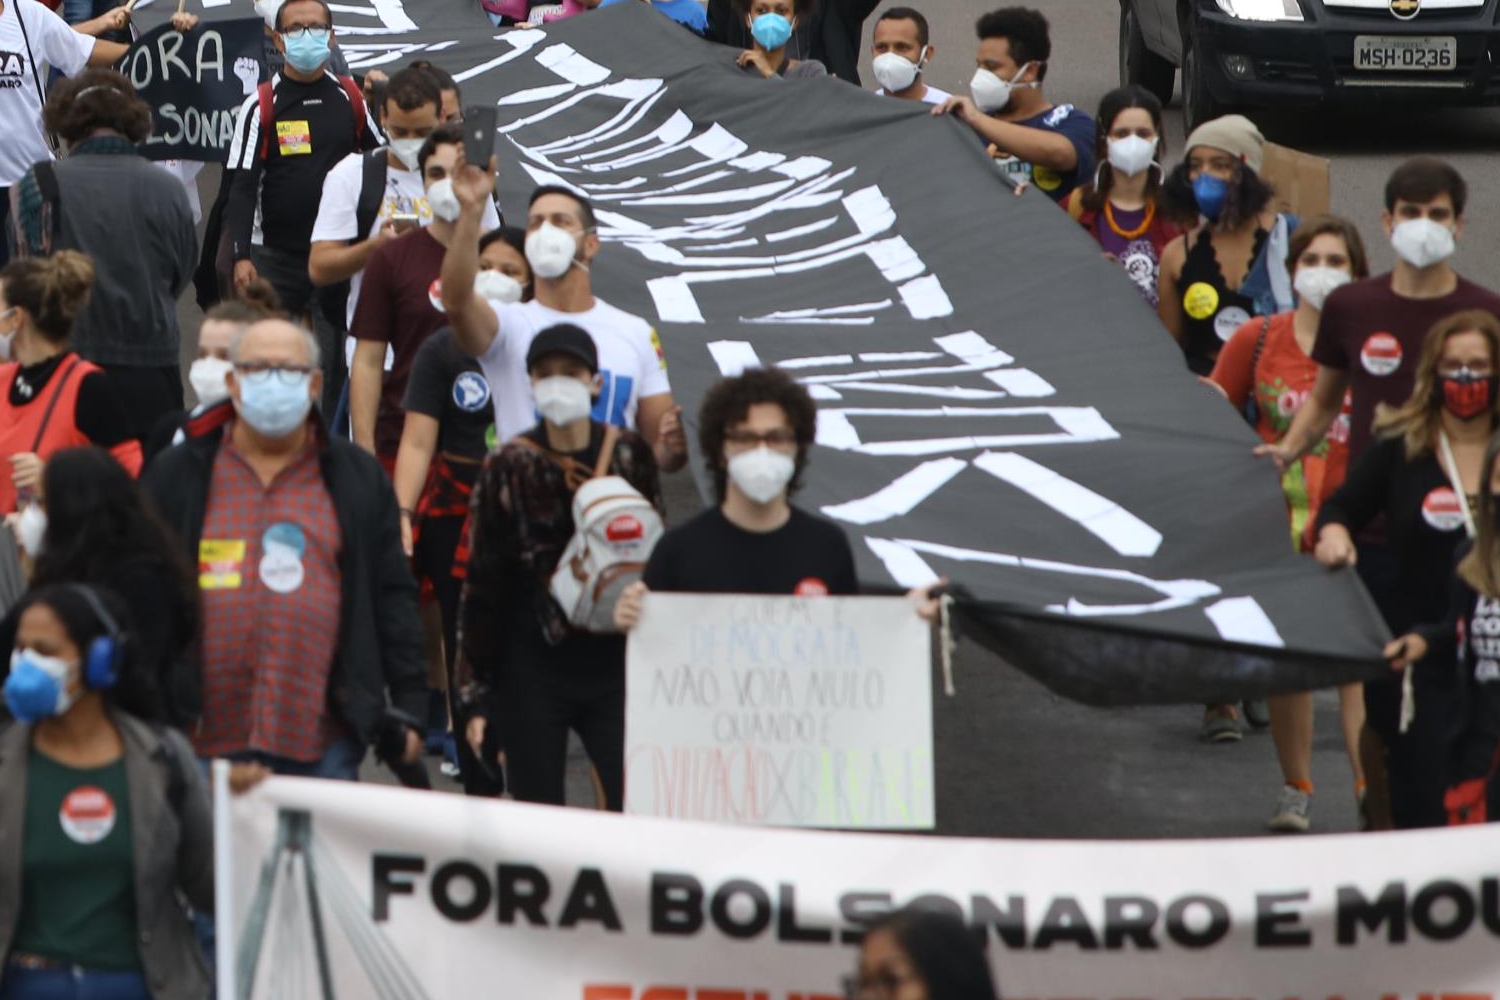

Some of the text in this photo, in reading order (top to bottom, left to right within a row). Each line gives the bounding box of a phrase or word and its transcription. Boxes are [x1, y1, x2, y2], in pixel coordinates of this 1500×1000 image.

[119, 29, 225, 91] ORA
[145, 101, 242, 149] LSONA
[649, 664, 886, 711] NÃO VOTA NULO
[712, 711, 816, 745] QUANDO
[371, 852, 623, 933] FORA
[1254, 891, 1313, 948] E
